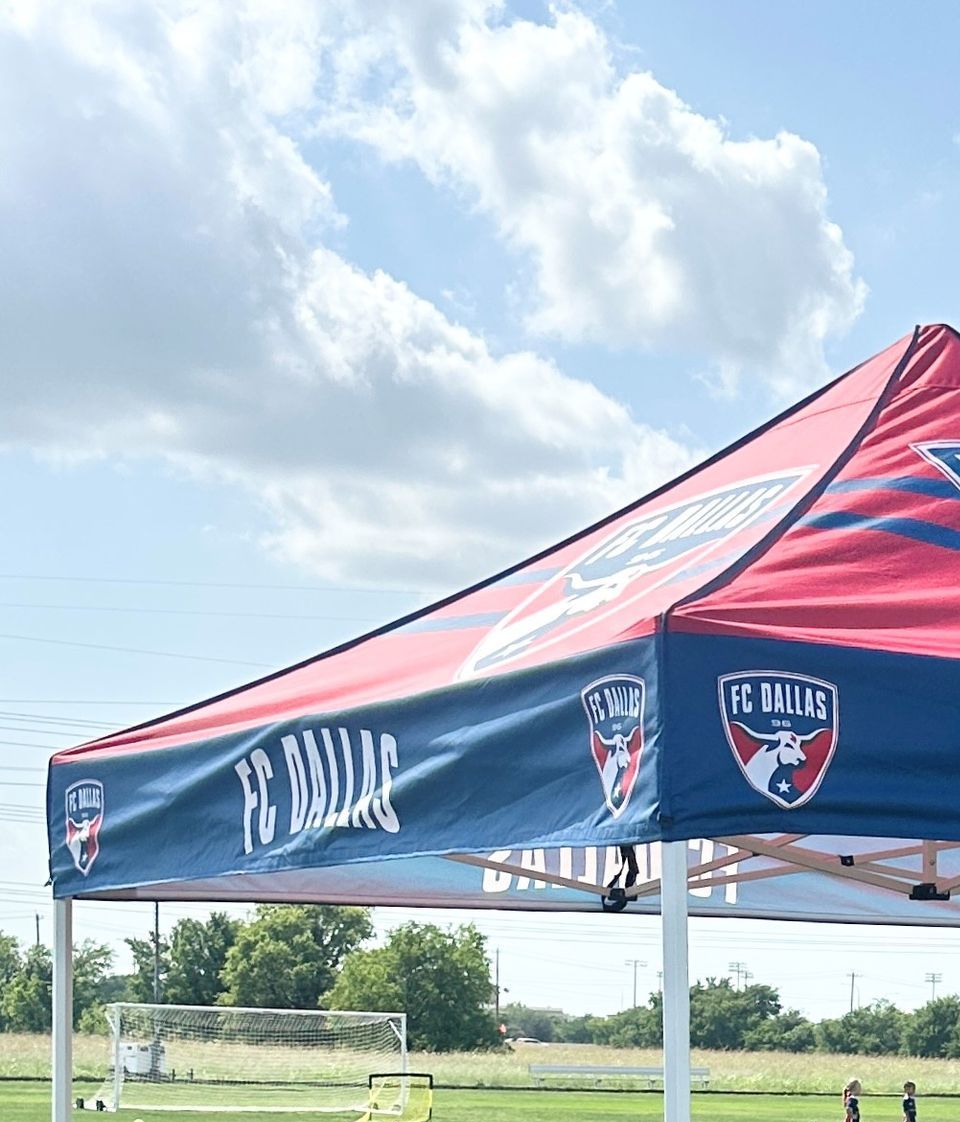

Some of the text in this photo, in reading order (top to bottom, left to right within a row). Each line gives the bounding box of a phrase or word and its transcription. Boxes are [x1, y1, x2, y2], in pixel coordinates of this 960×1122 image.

[588, 686, 640, 724] FC DALLAS
[730, 682, 827, 720] FC DALLAS
[234, 728, 400, 855] FC DALLAS
